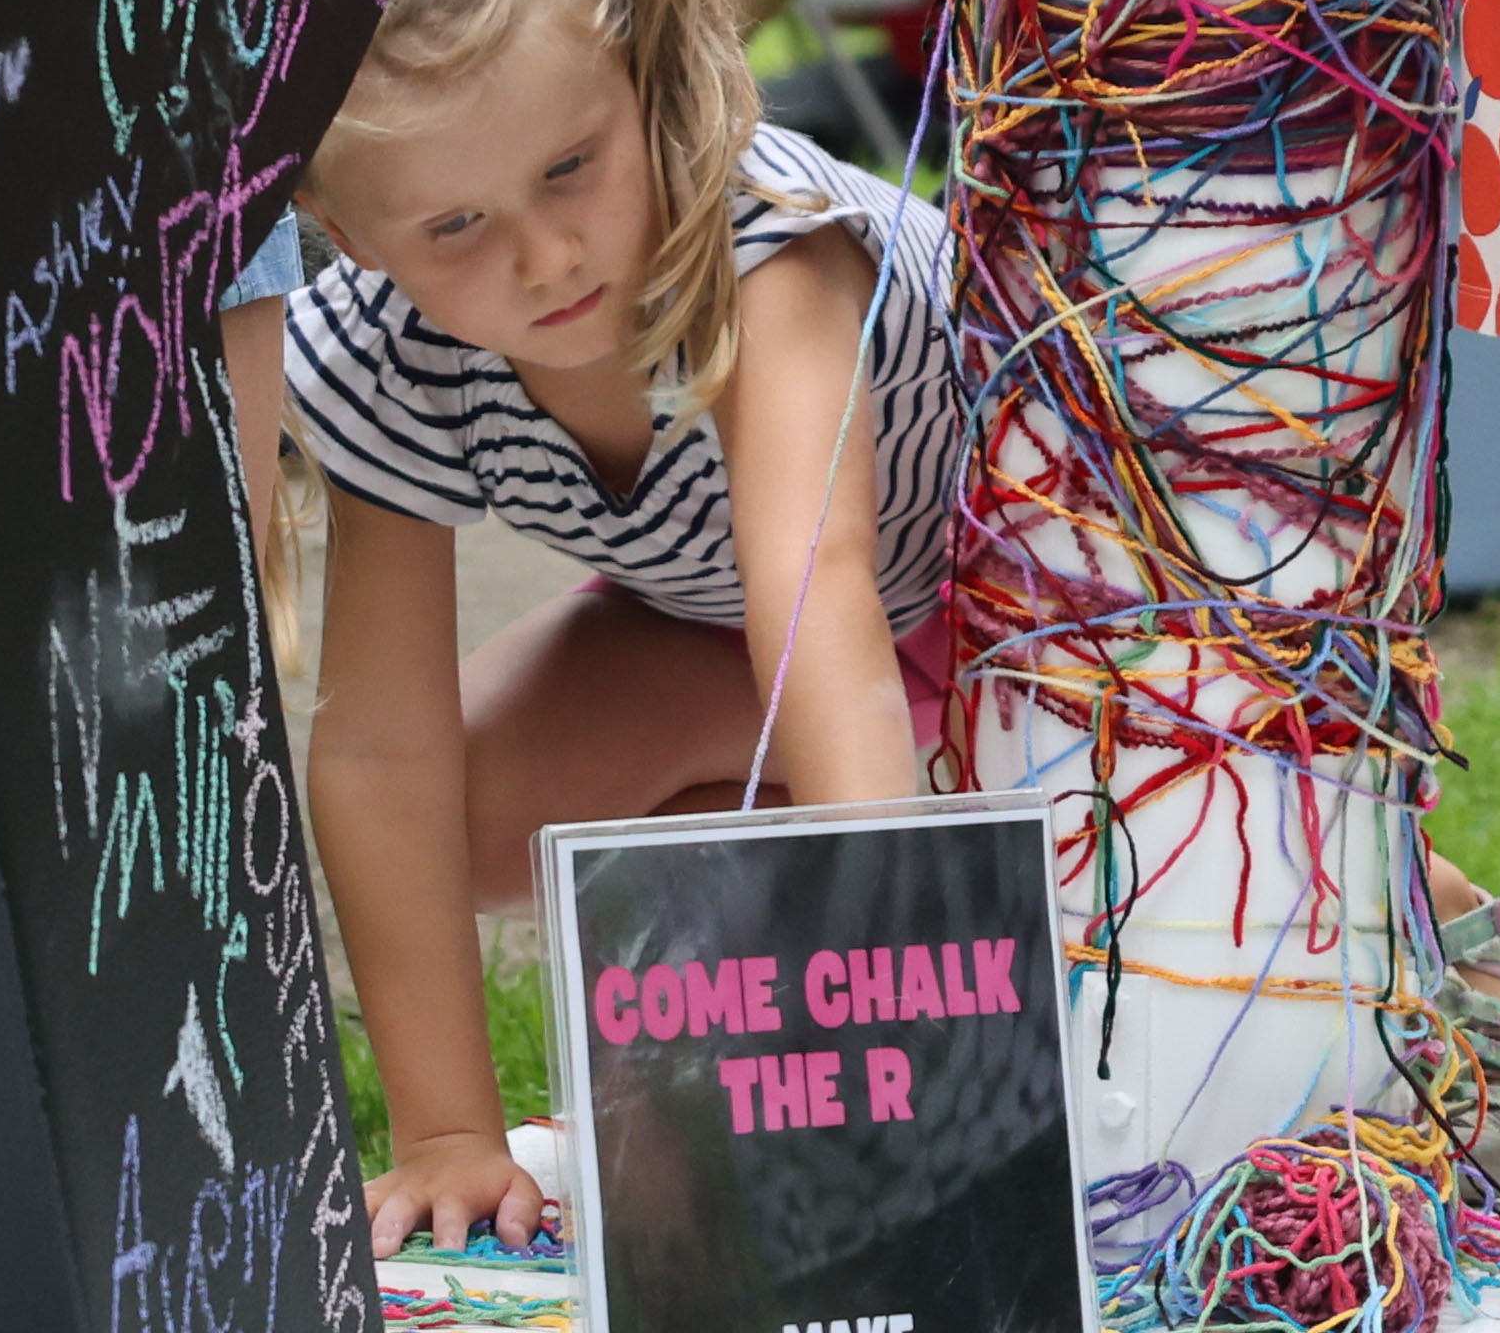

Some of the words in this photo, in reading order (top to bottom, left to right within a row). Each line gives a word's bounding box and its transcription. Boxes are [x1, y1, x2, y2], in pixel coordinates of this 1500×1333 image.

[595, 956, 783, 1044] COME
[804, 937, 1022, 1029] CHALK
[718, 1050, 847, 1135] THE
[865, 1047, 915, 1123] R
